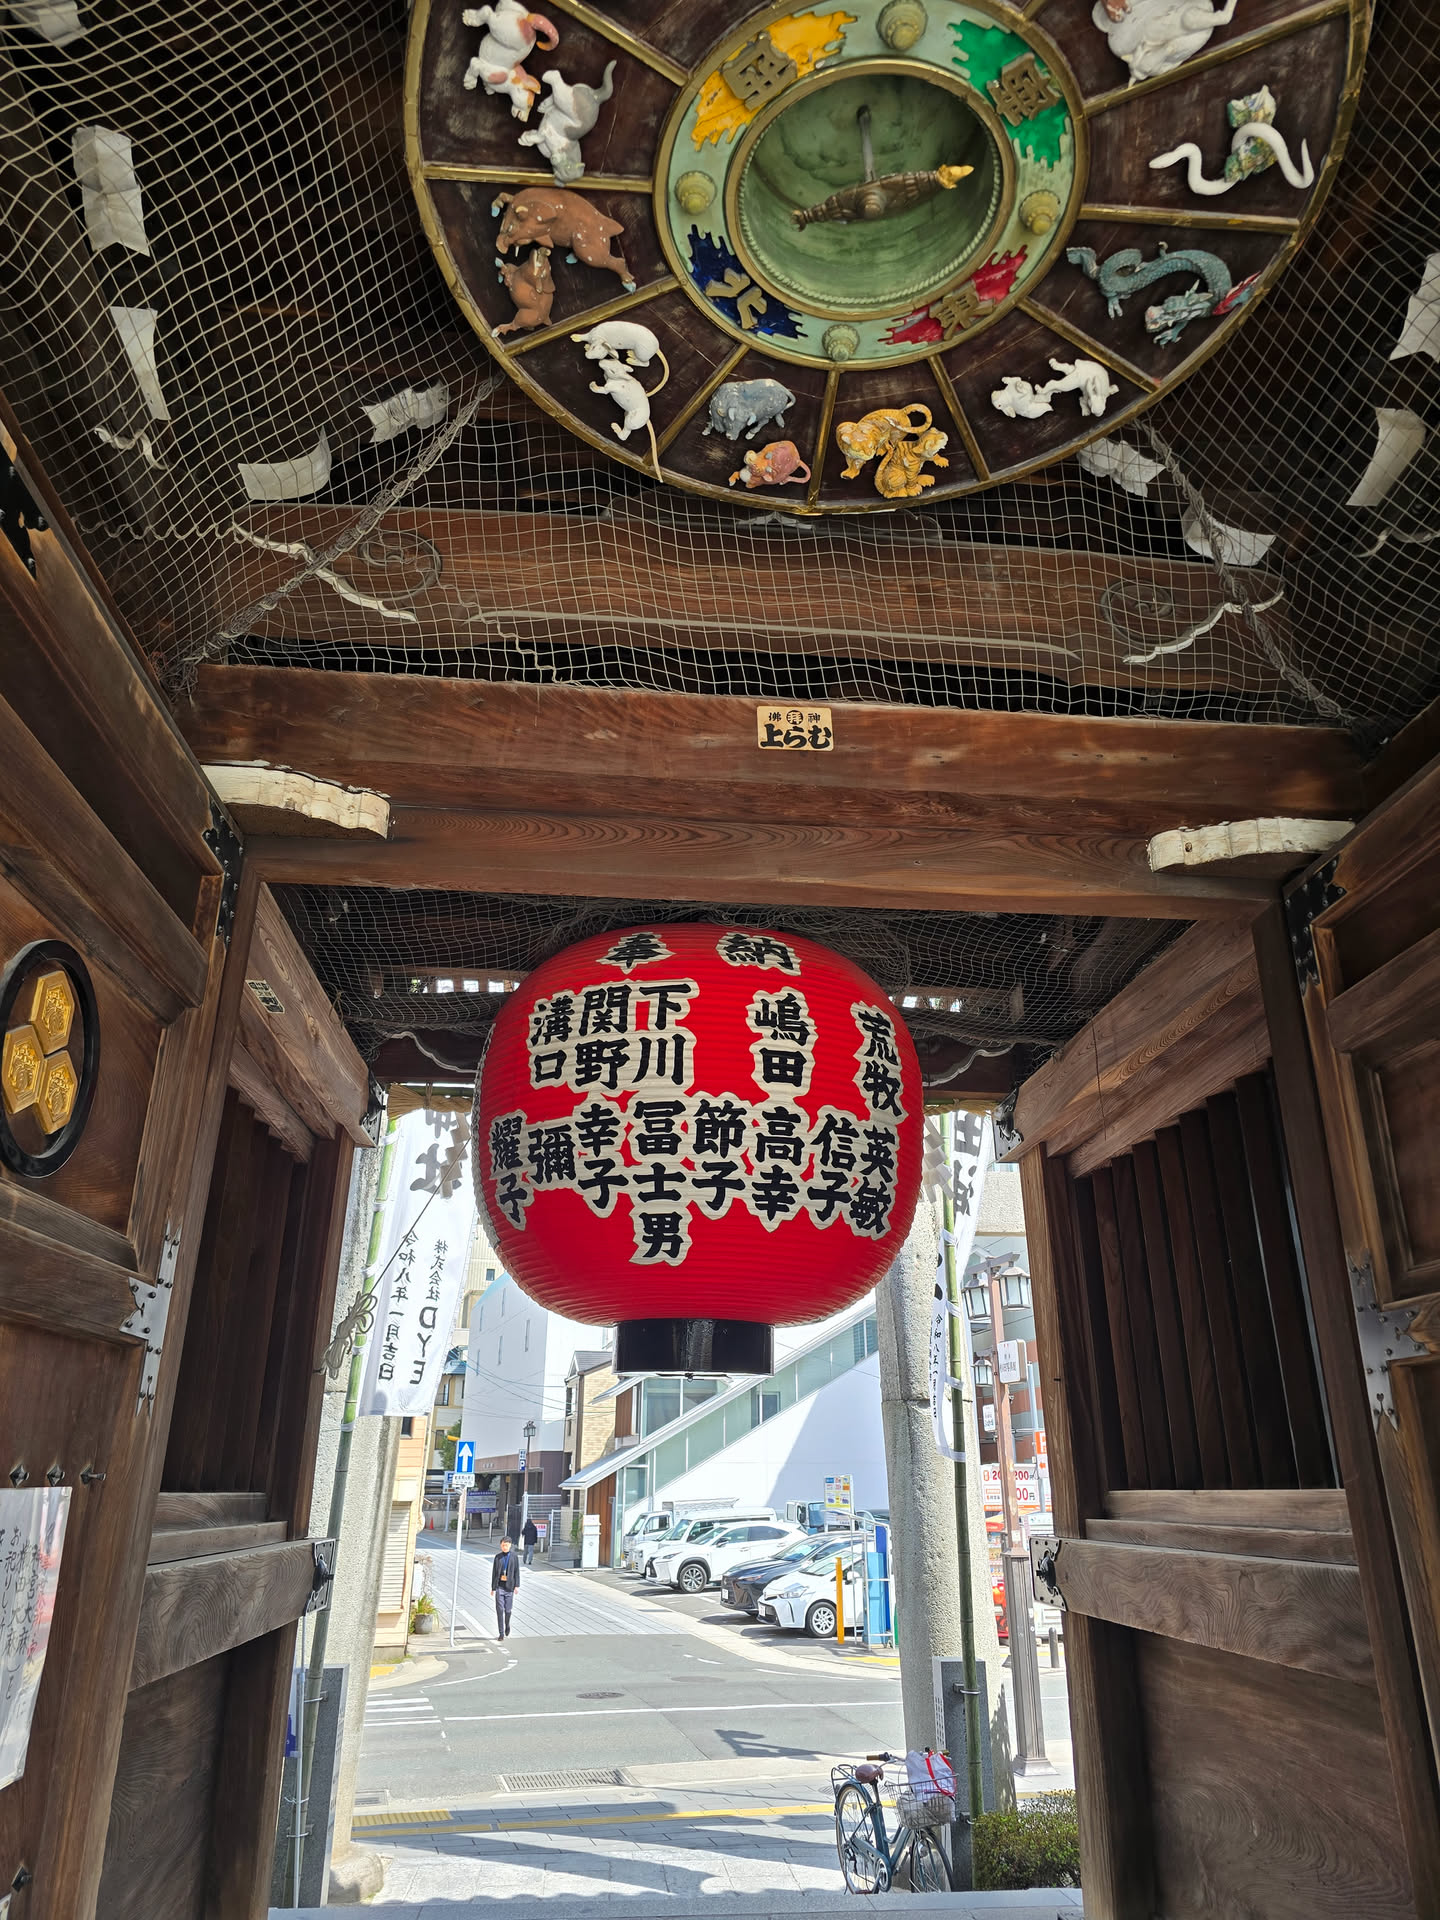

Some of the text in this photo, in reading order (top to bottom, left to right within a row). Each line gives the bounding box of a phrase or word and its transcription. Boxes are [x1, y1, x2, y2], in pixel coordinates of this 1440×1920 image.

[722, 33, 798, 110] 西
[986, 53, 1062, 126] 南
[706, 268, 767, 330] 北
[930, 284, 995, 340] 東
[605, 932, 795, 970] 奉納
[574, 984, 631, 1210] 関野幸子
[751, 993, 810, 1221] 嶋田高幸
[849, 1010, 903, 1234] 荒牧英敏
[691, 1099, 748, 1212] 節子
[807, 1113, 861, 1222] 信子
